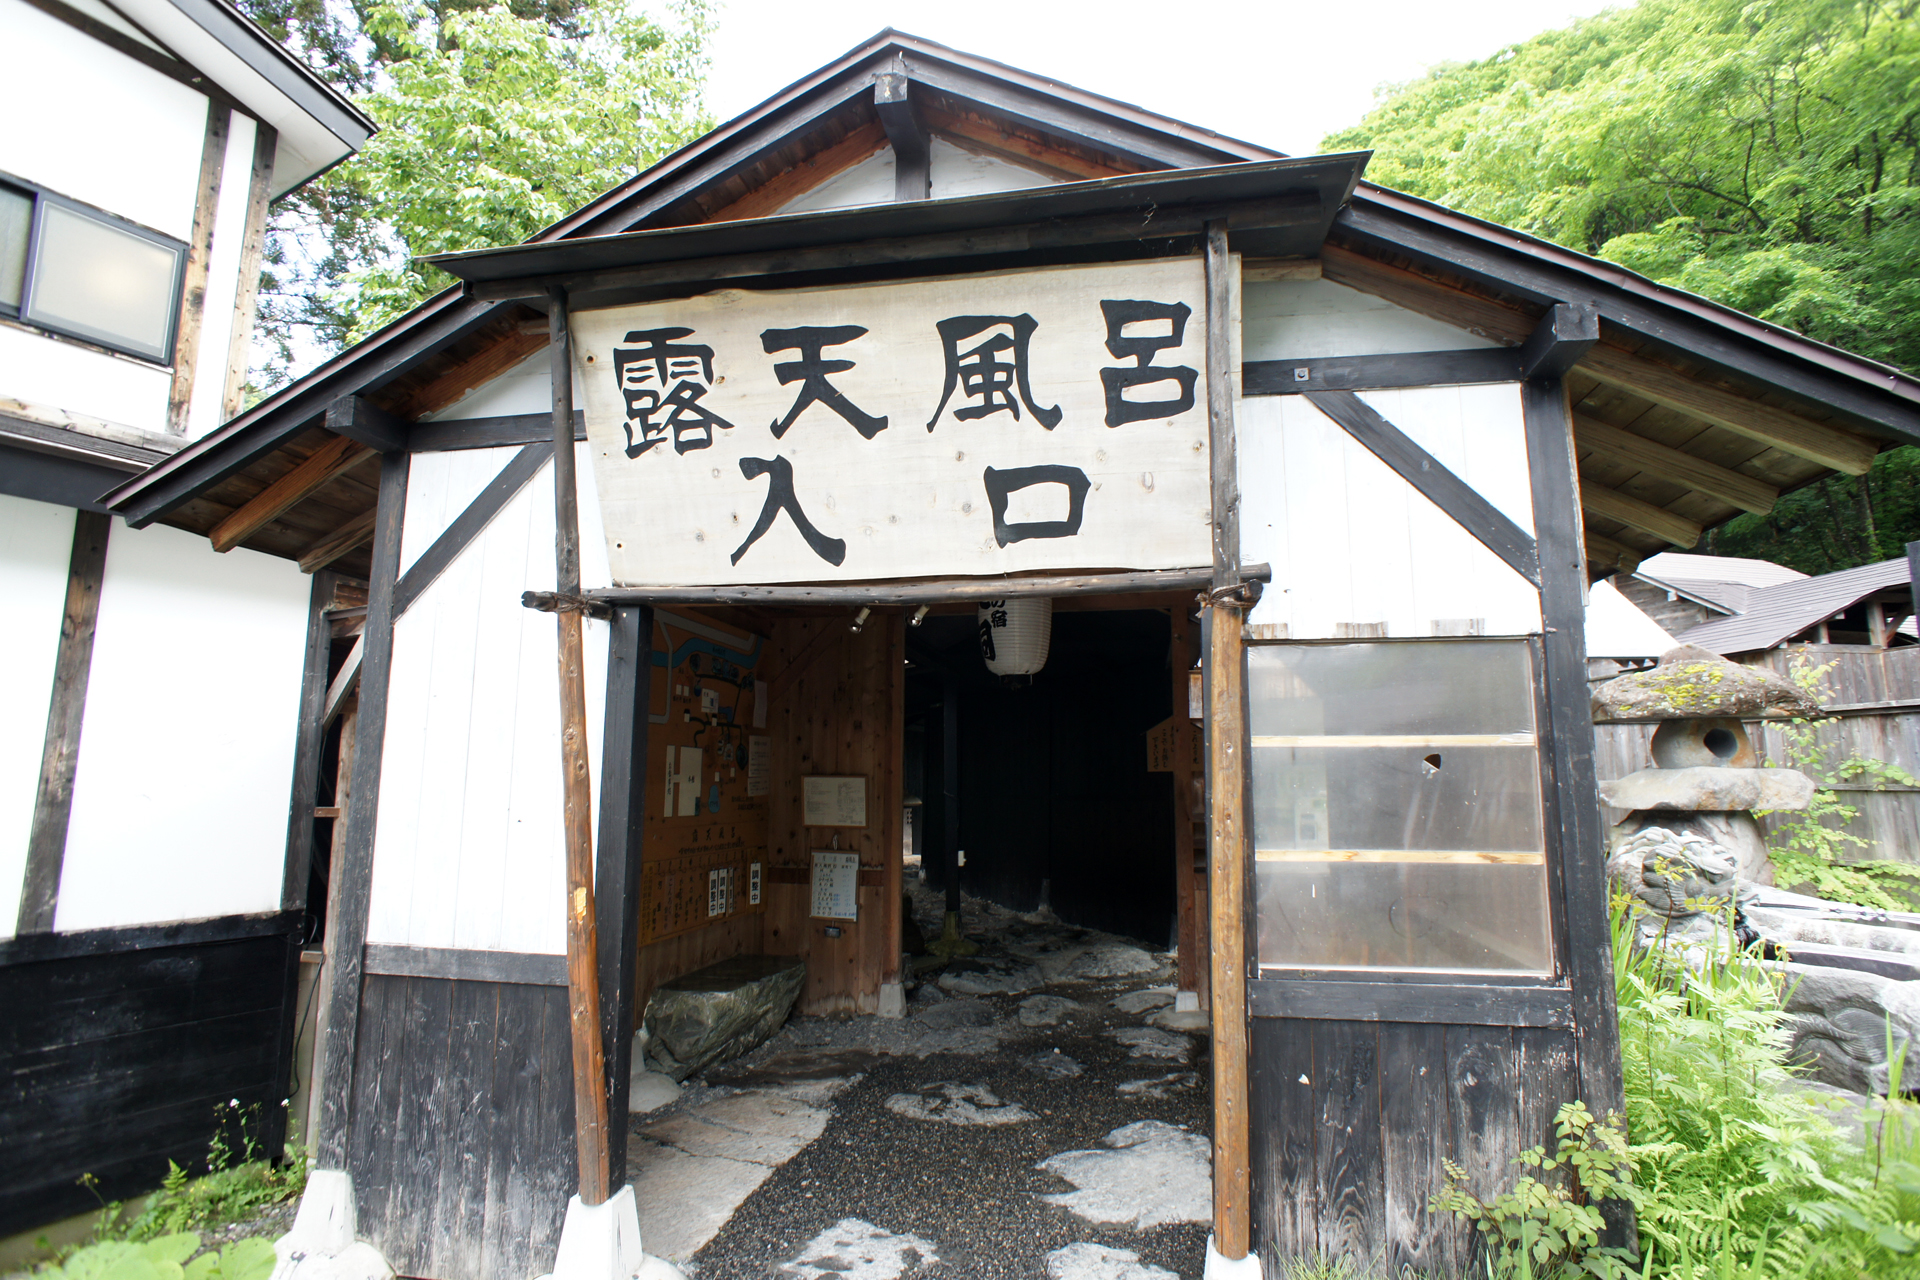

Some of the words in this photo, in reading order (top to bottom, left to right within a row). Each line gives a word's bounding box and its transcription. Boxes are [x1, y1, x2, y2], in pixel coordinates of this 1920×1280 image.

[613, 299, 1199, 460] 露天風呂
[730, 454, 1092, 567] 入口
[752, 870, 760, 902] 調整中
